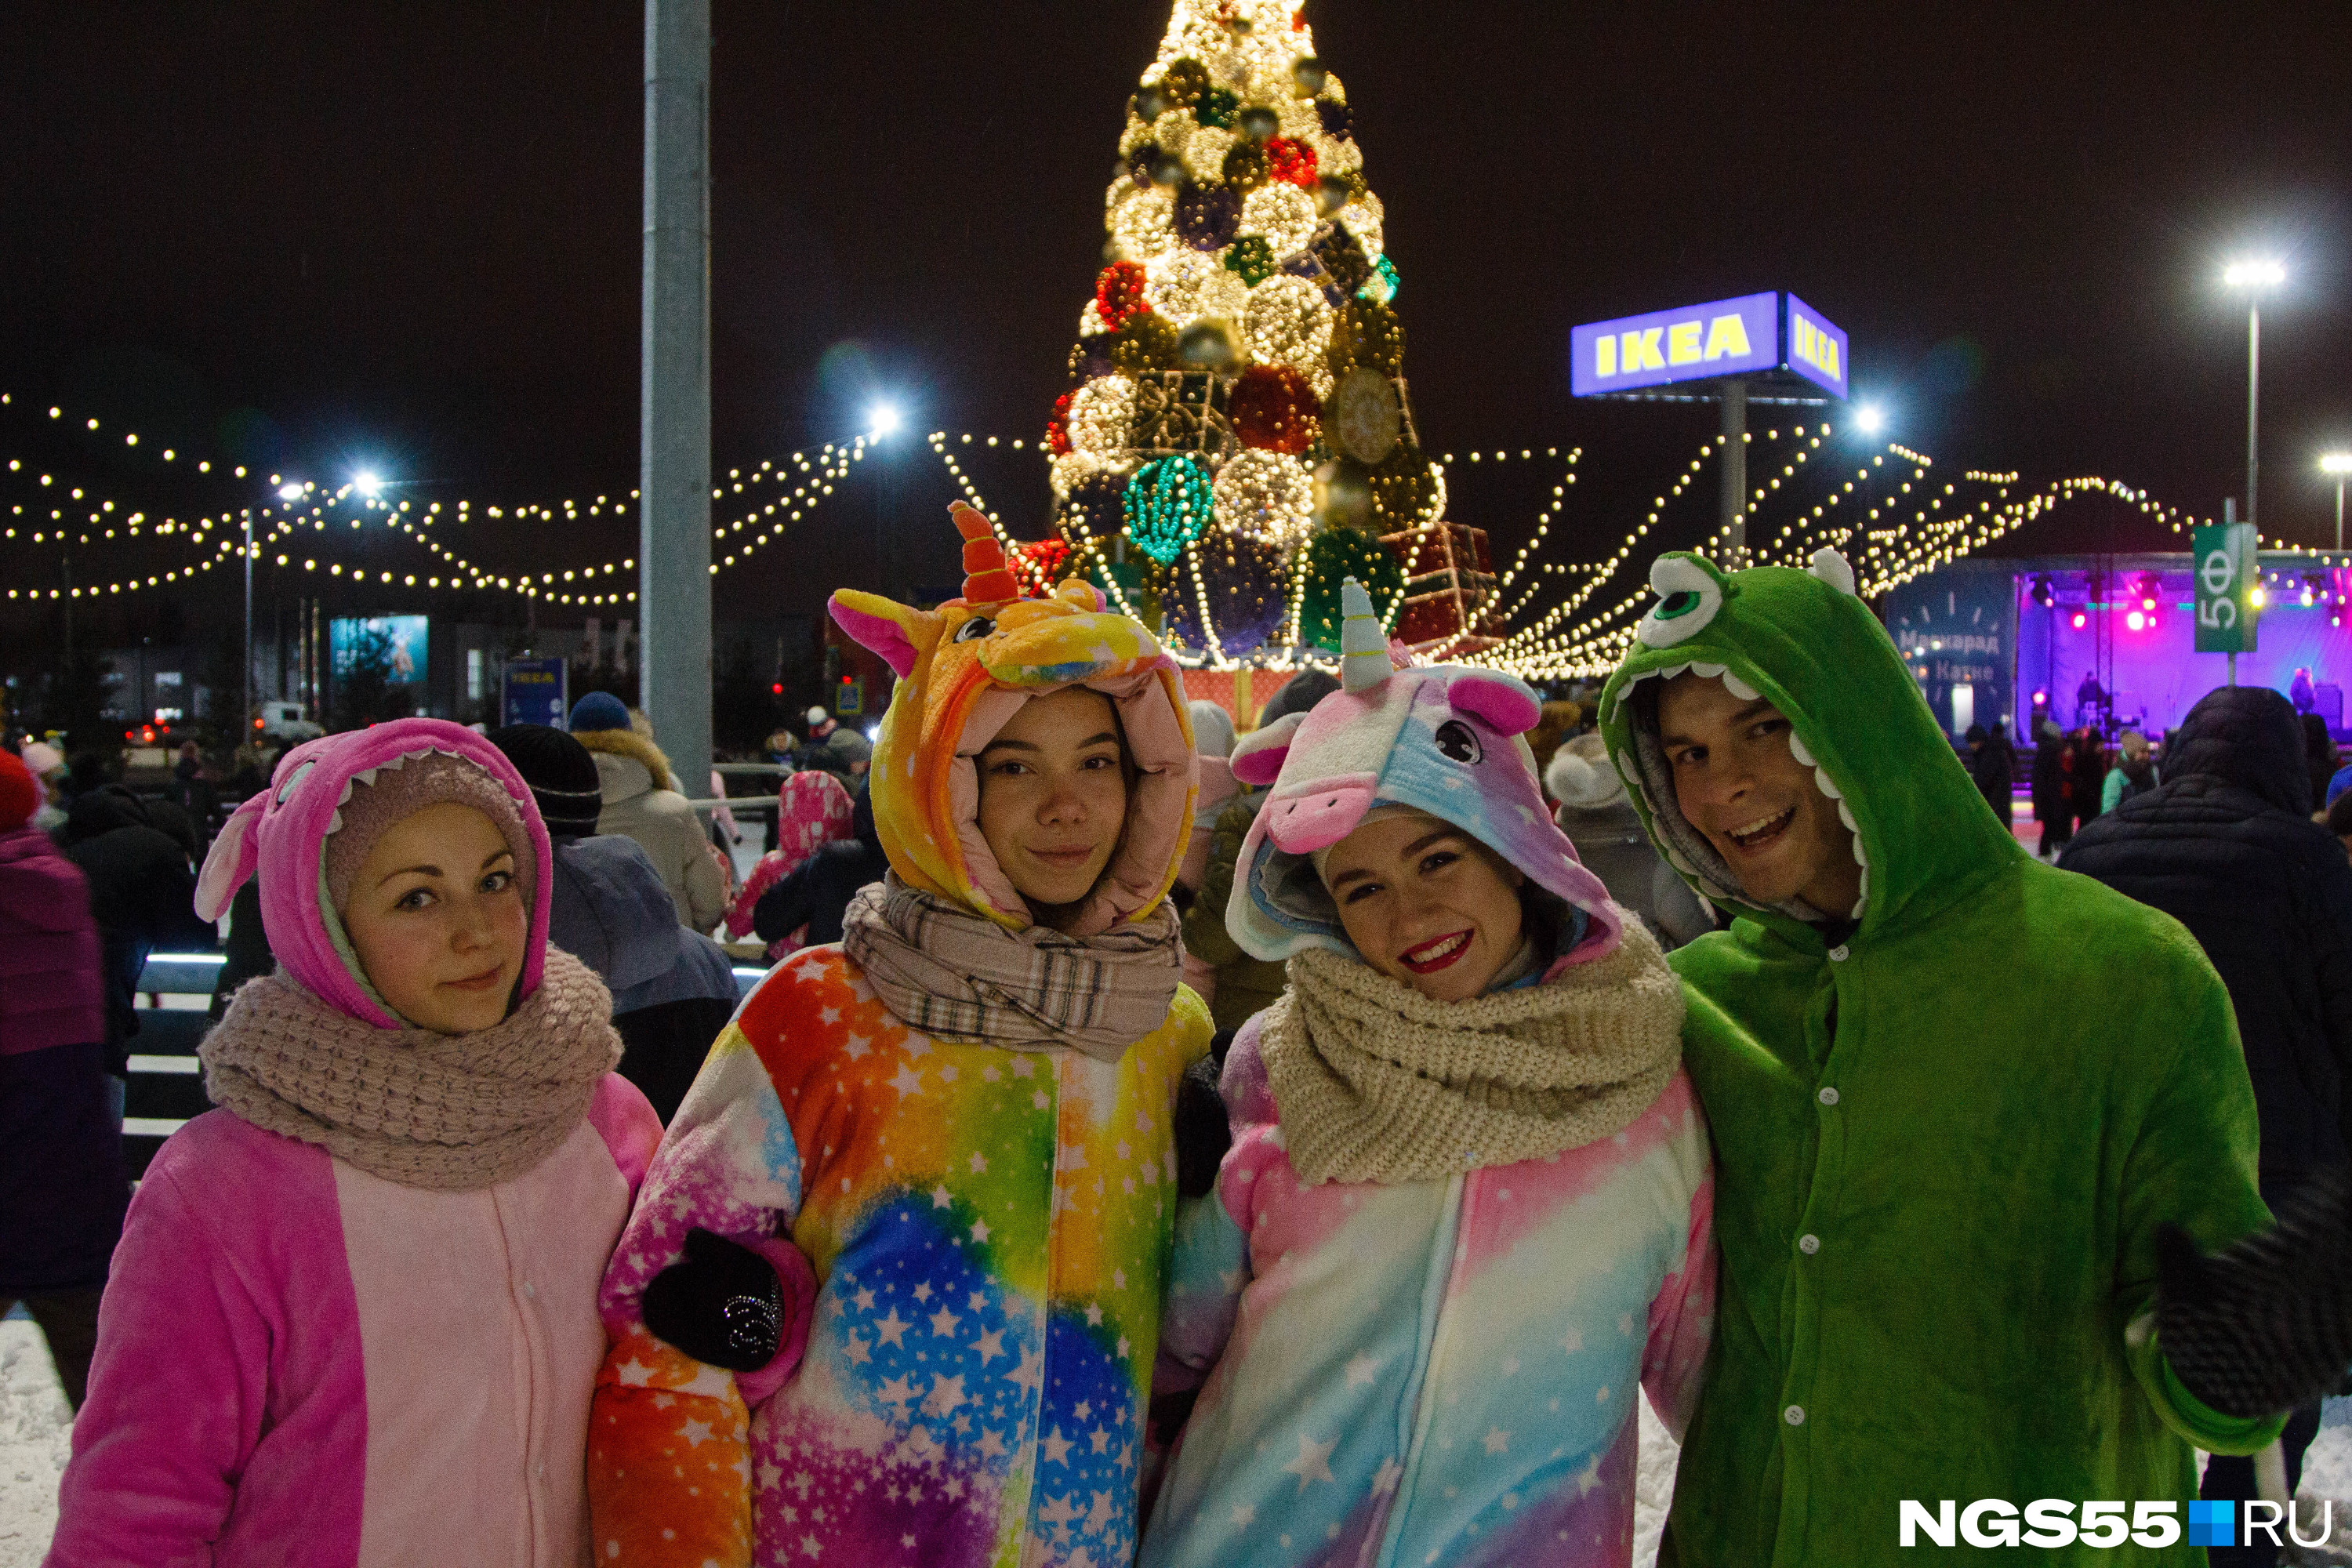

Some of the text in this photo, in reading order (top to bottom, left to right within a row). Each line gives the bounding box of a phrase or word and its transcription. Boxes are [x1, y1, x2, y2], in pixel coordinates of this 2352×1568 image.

[1595, 313, 1751, 379] IKEA
[1794, 313, 1842, 381] IKEA
[2200, 550, 2237, 630] 5Ф
